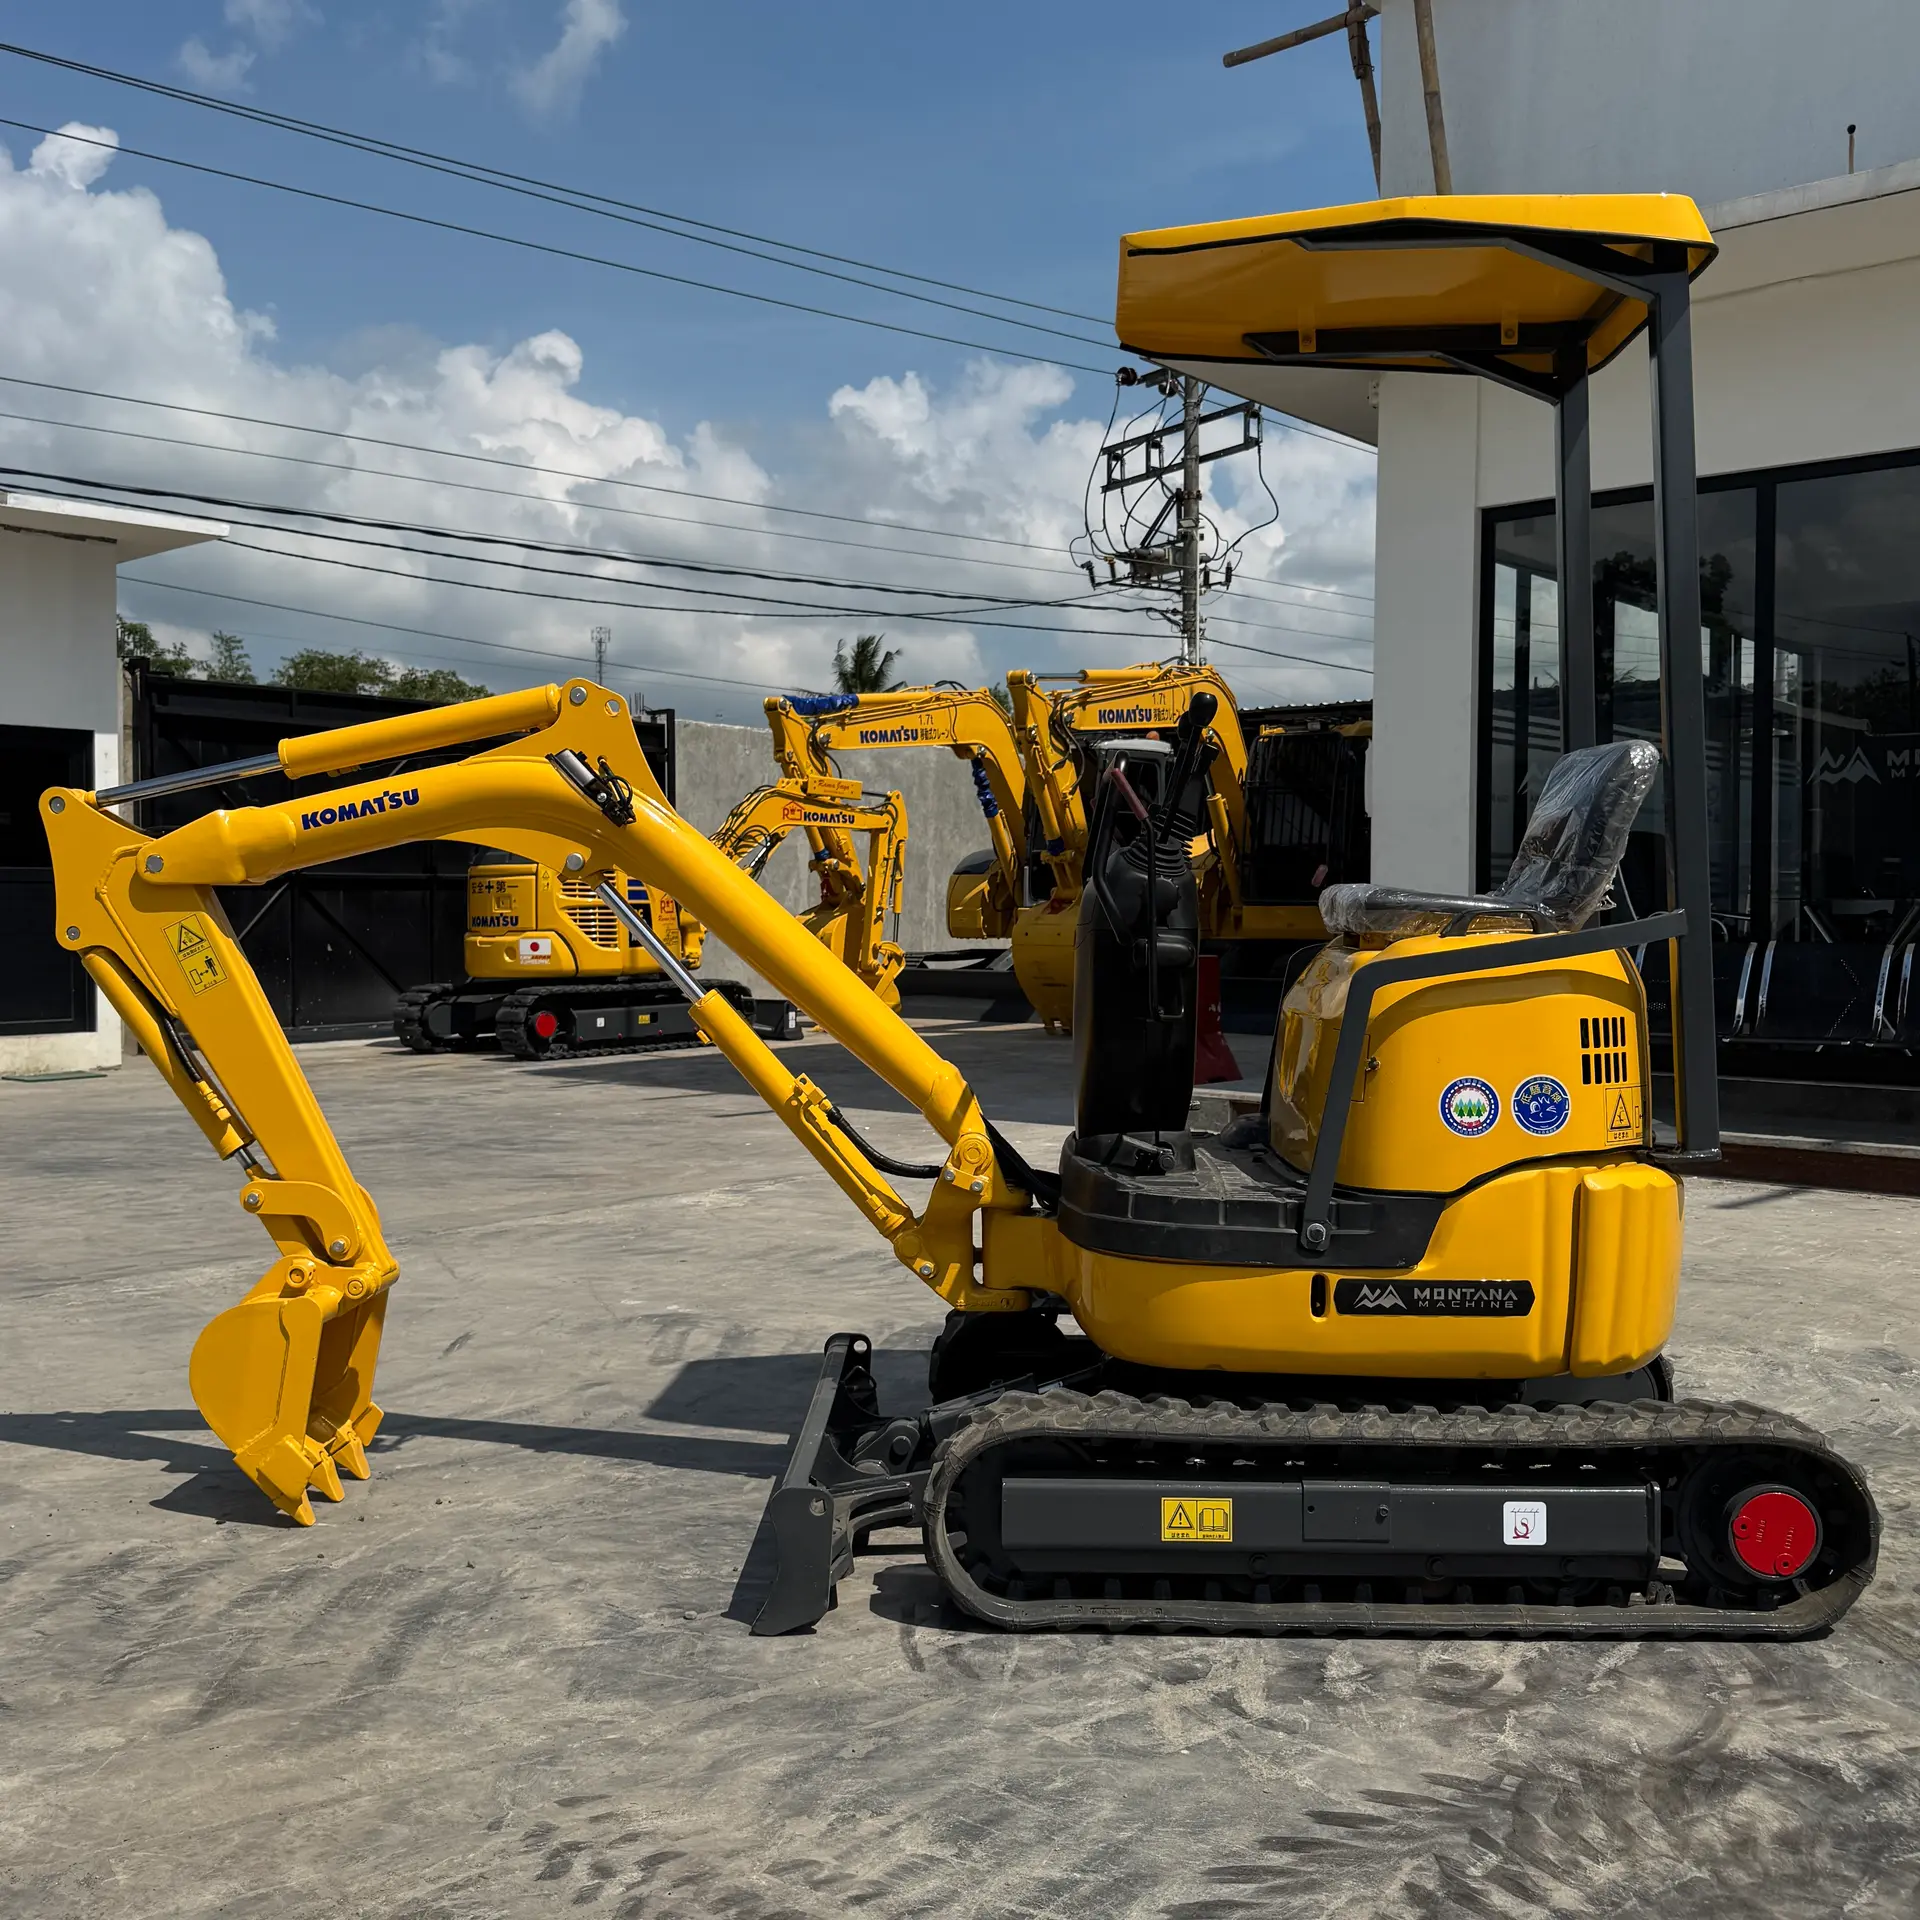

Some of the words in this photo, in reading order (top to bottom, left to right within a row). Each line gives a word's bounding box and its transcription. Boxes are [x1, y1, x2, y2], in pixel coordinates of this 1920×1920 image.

[1152, 692, 1167, 705] 1.7t
[918, 713, 934, 725] 1.7t
[1098, 704, 1152, 724] KOMATSU
[860, 725, 918, 744] KOMATSU
[301, 788, 420, 831] KOMATSU
[803, 811, 855, 824] KOMATSU
[471, 912, 519, 928] KOMATSU
[1413, 1287, 1518, 1301] MONTANA
[1418, 1300, 1514, 1309] MACHINE
